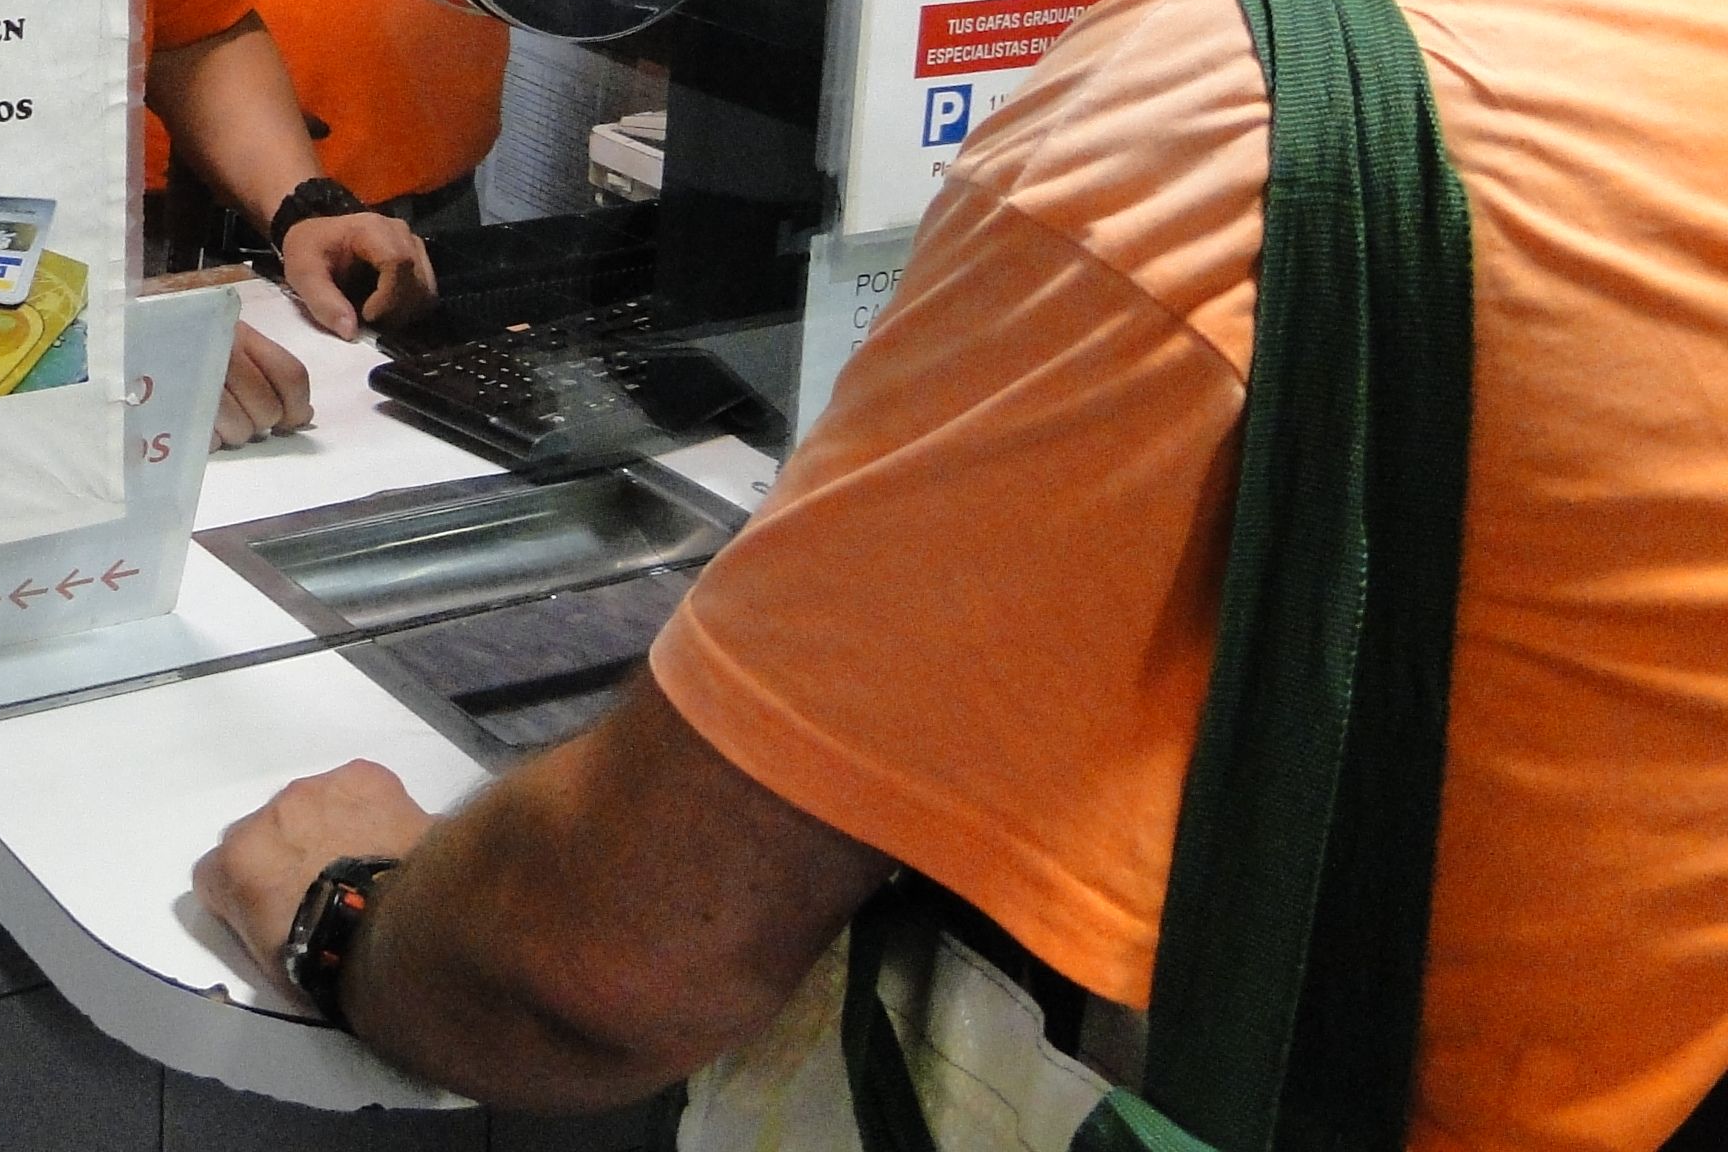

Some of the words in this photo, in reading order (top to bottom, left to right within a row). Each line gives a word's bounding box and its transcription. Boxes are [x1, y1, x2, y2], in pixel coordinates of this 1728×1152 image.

[948, 17, 973, 34] TUS
[975, 12, 1020, 31] GAFAS
[1023, 5, 1087, 27] GRADUAD
[927, 40, 1029, 65] ESPECIALISTAS
